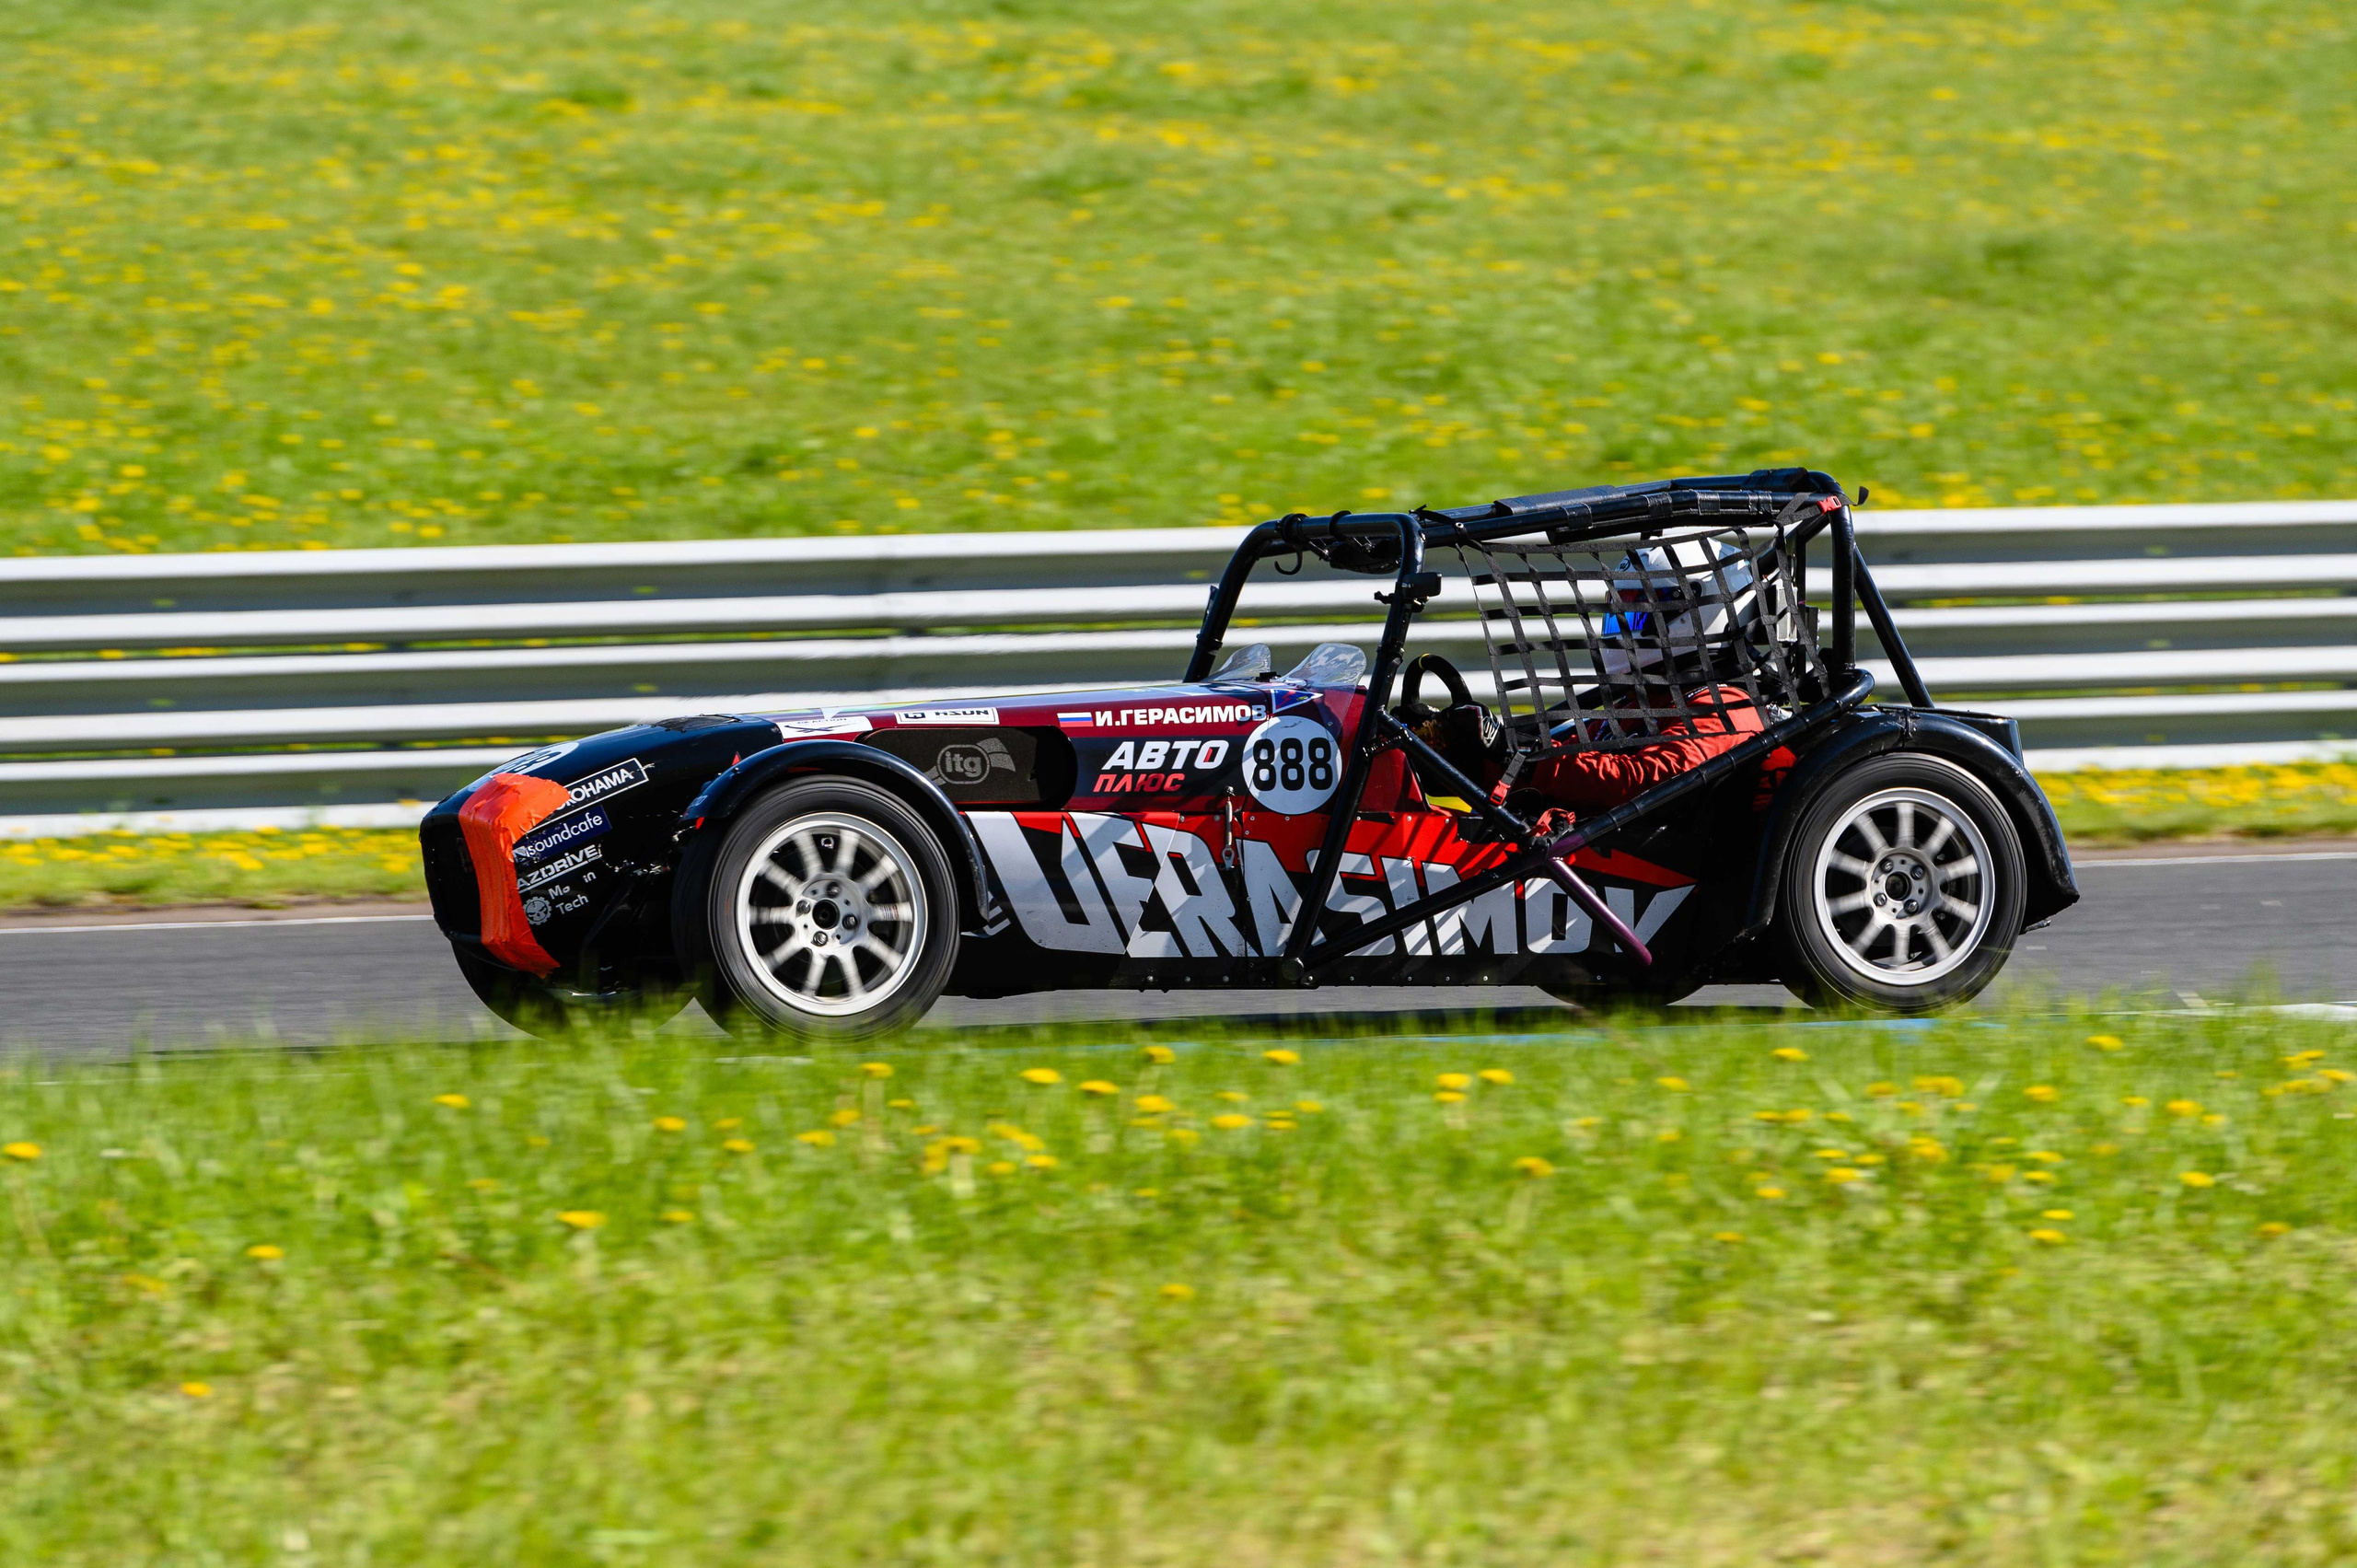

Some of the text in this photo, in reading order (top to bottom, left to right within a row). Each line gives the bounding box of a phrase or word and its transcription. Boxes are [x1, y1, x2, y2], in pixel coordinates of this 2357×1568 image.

[1095, 704, 1268, 726] И.ГЕРАСИМОВ
[945, 750, 982, 778] itg
[1102, 739, 1229, 771] АВТО
[1252, 738, 1333, 792] 888
[555, 894, 588, 914] Tech
